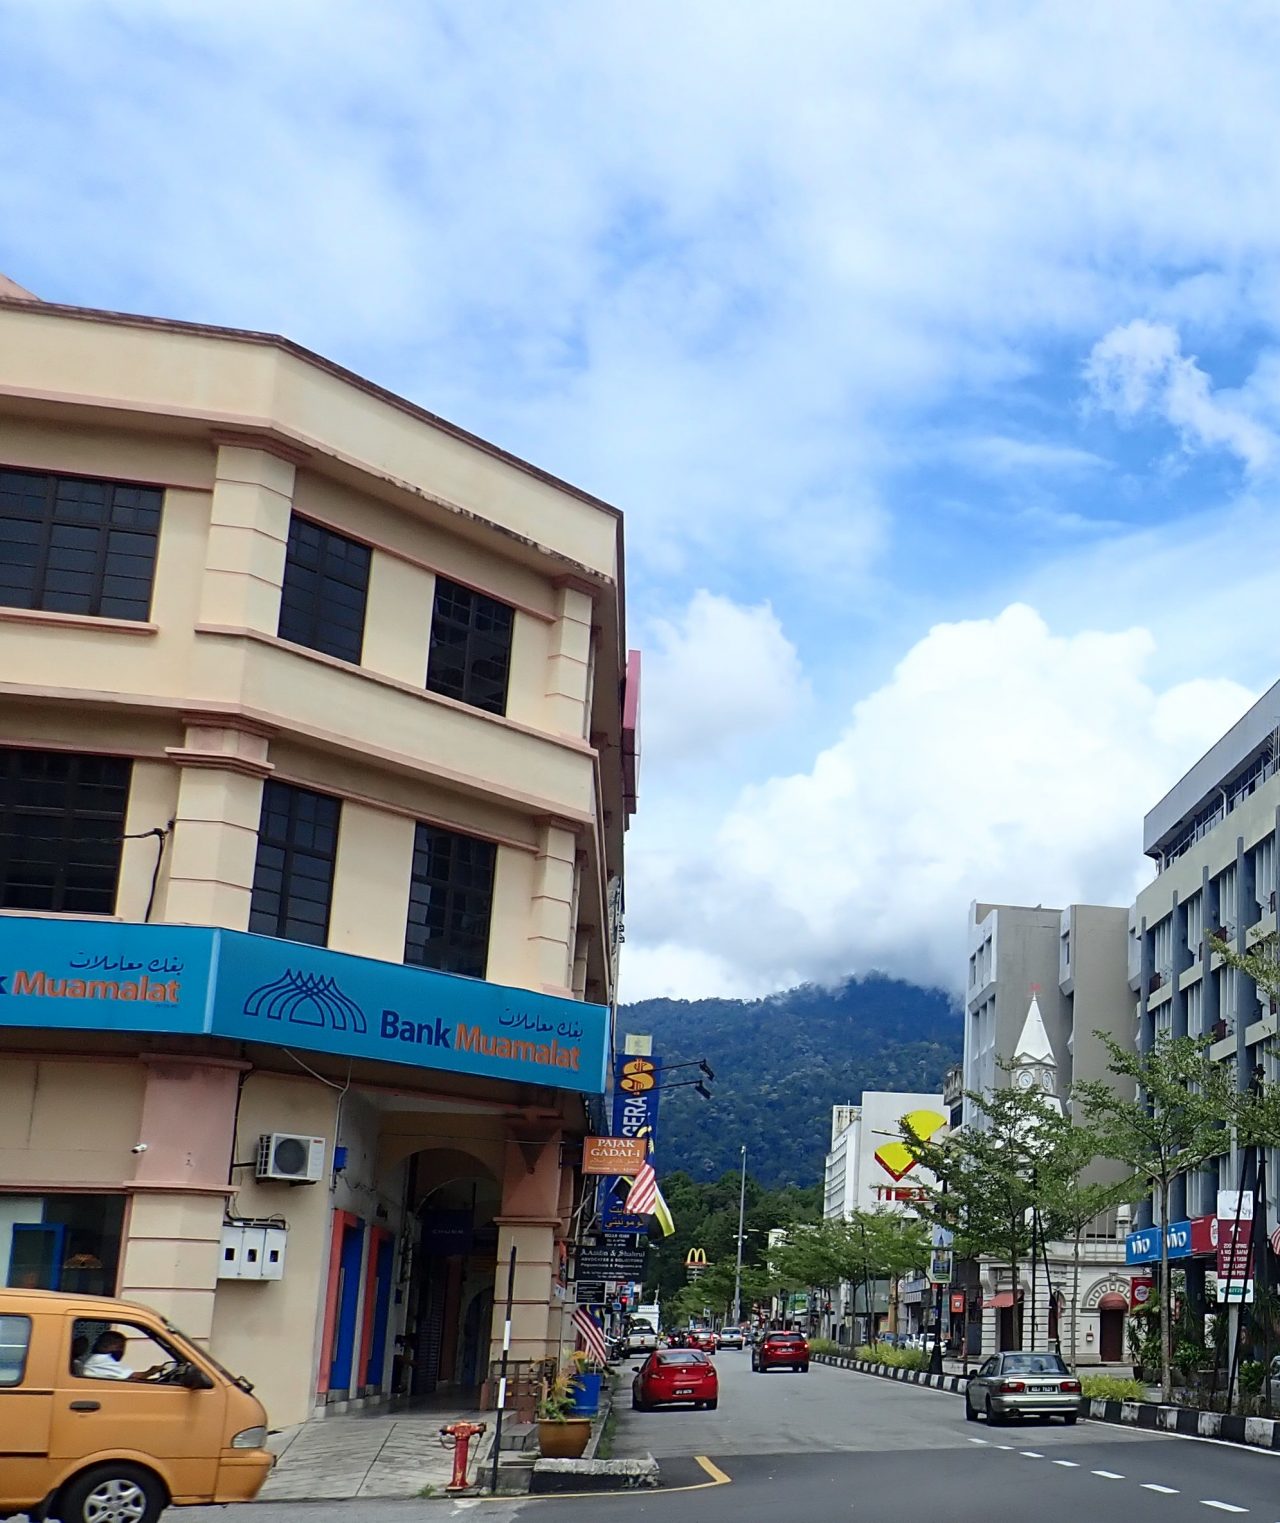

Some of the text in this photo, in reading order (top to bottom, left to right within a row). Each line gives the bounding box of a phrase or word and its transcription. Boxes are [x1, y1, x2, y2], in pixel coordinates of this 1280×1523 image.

[12, 969, 181, 1003] Muamalat
[380, 1008, 581, 1070] Bank Muamalat
[598, 1139, 636, 1148] PAJAK
[1131, 1235, 1151, 1255] vivo
[1166, 1228, 1187, 1248] vivo
